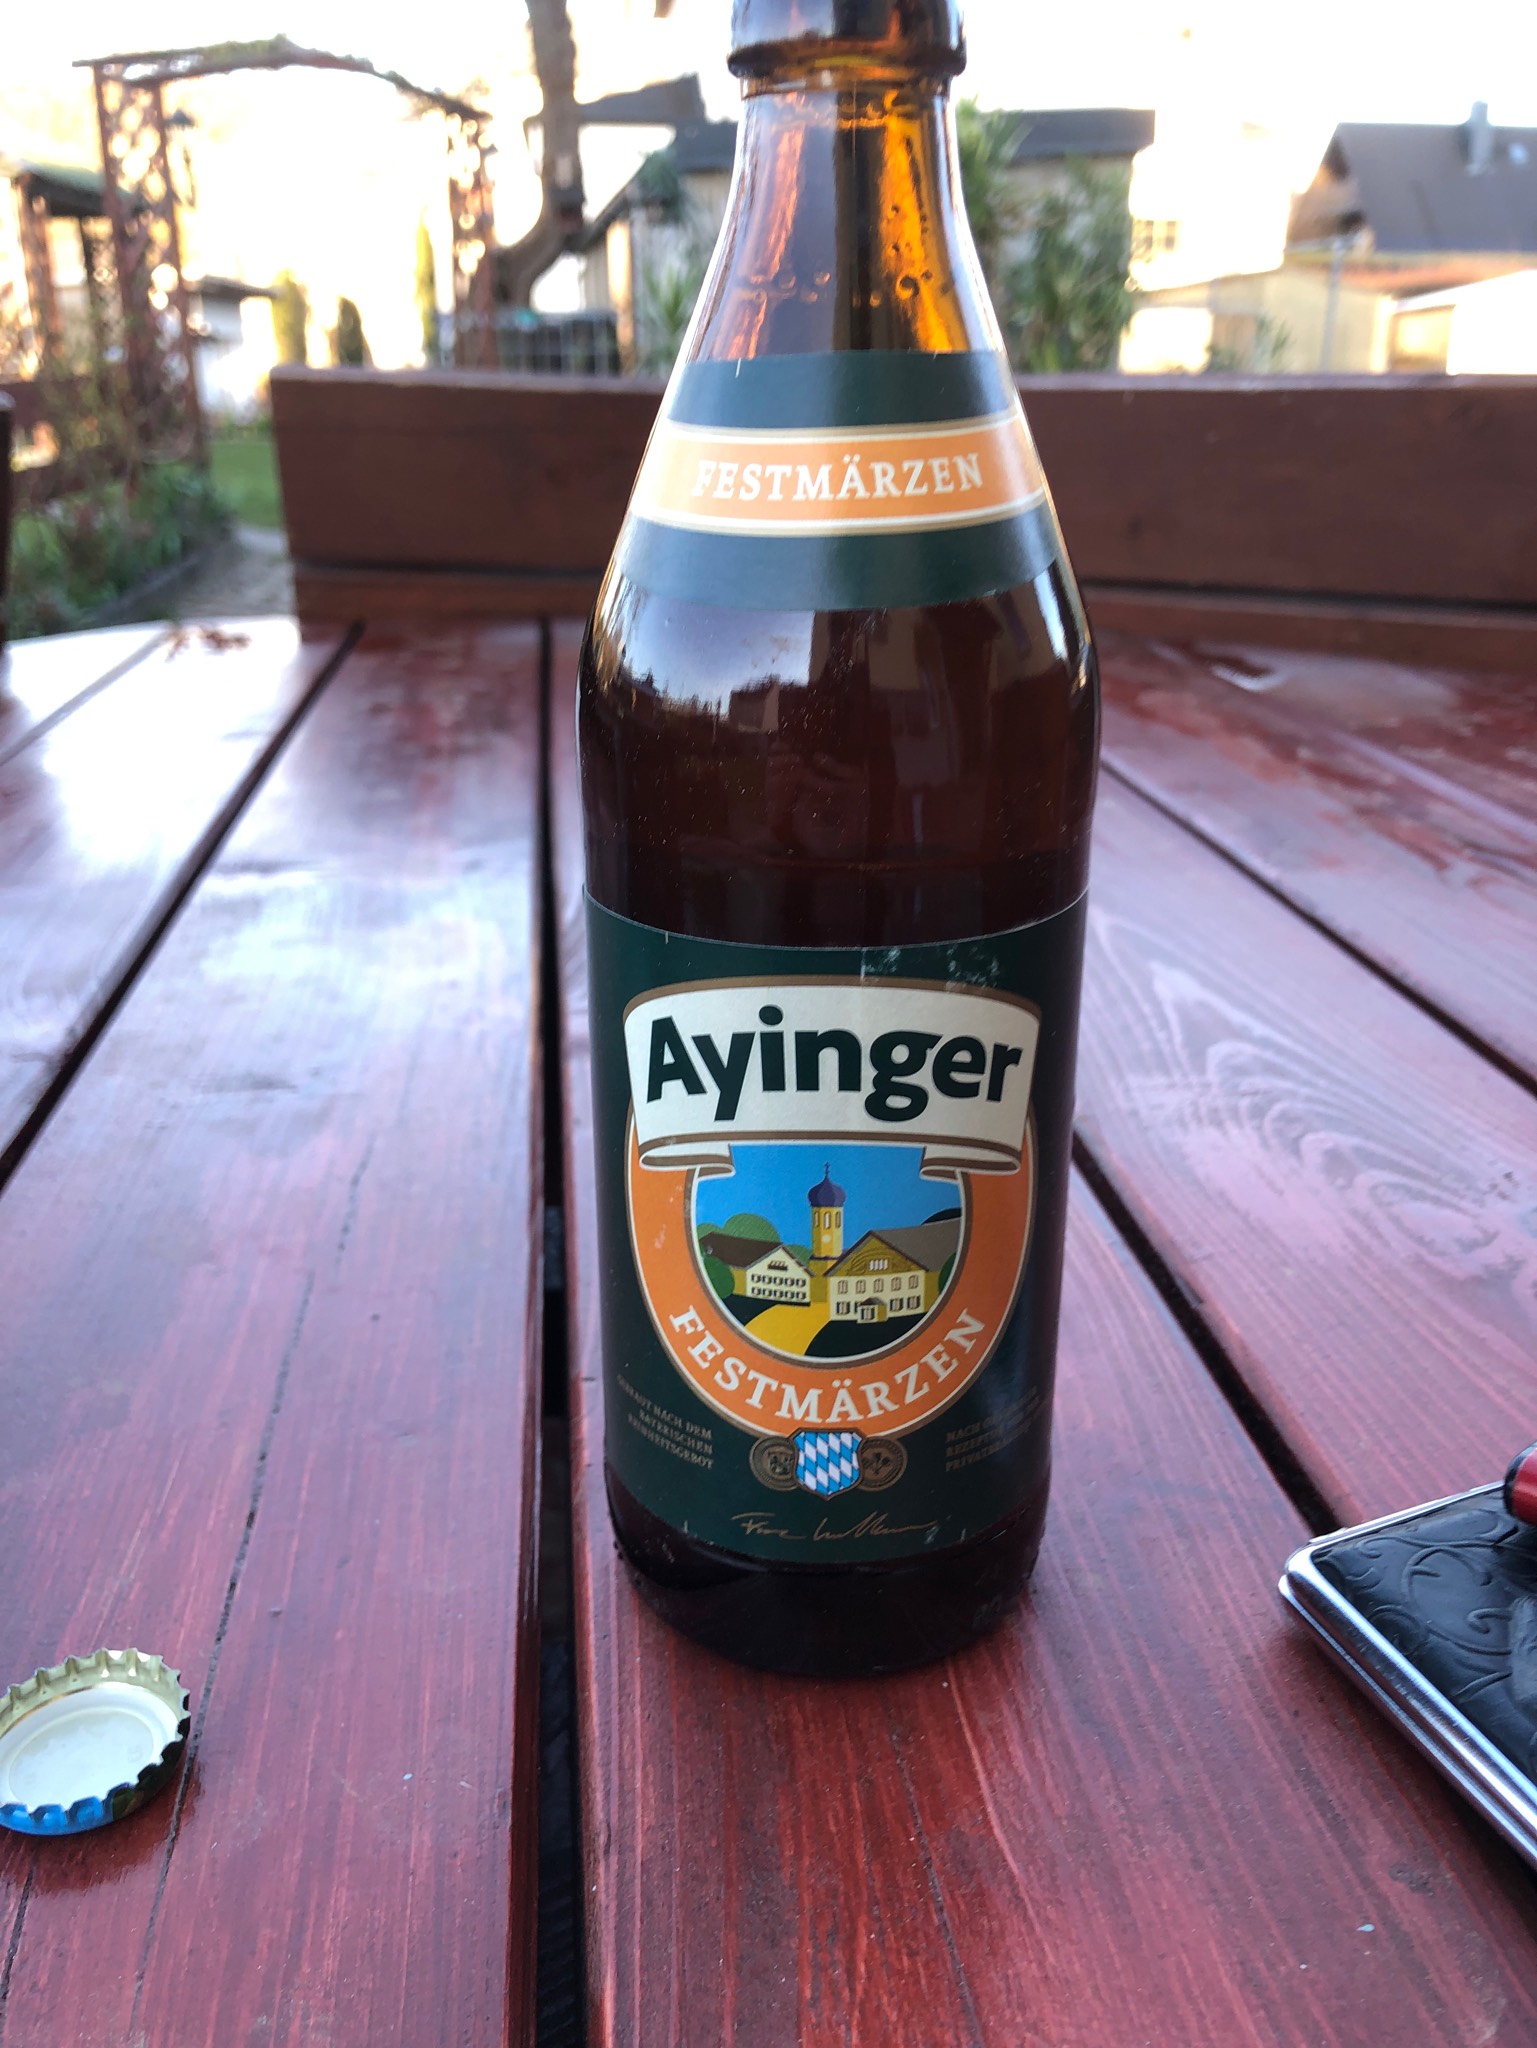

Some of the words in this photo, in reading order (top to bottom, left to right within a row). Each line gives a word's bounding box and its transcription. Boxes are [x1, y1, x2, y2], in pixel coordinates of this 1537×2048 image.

[691, 453, 984, 501] FESTMÄRZEN
[646, 1004, 1023, 1122] Ayinger
[668, 1305, 986, 1424] FESTMÄRZEN
